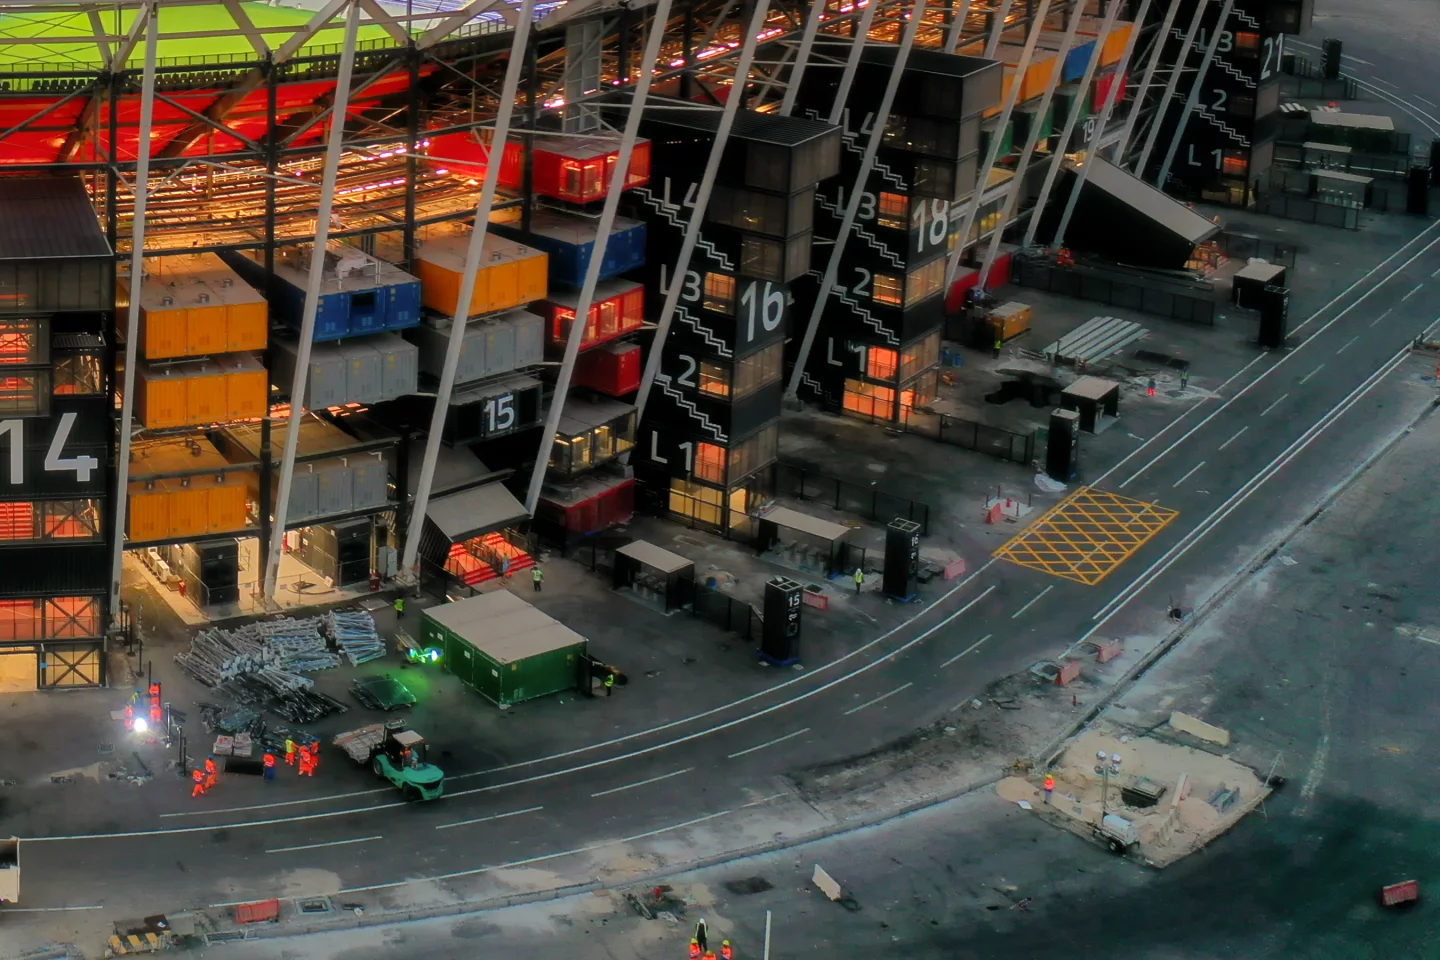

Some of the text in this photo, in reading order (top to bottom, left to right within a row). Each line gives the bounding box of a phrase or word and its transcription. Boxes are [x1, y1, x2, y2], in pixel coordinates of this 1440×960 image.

[1261, 33, 1284, 80] 21
[913, 198, 948, 253] 18
[741, 281, 784, 342] 16
[484, 395, 515, 432] 15
[788, 593, 800, 607] 15
